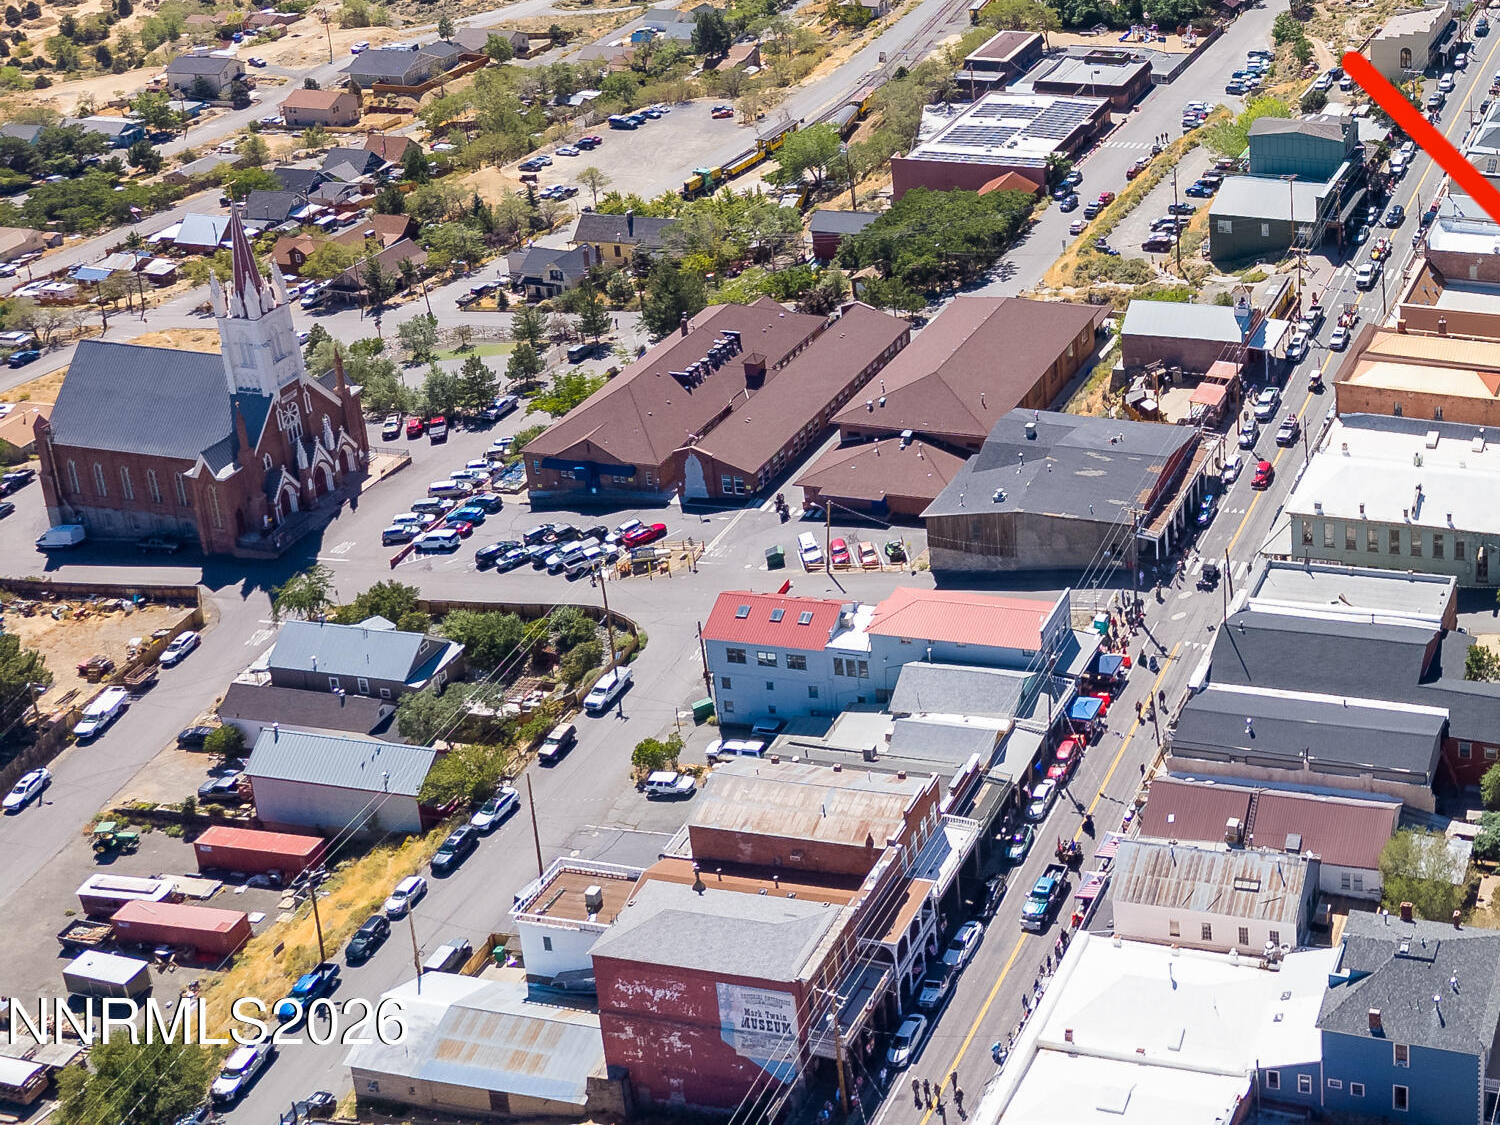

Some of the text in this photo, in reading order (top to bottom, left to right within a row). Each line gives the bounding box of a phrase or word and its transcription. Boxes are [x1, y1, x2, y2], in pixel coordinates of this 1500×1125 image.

[744, 1007, 788, 1022] Mark Twain
[741, 1016, 793, 1035] MUSEUM
